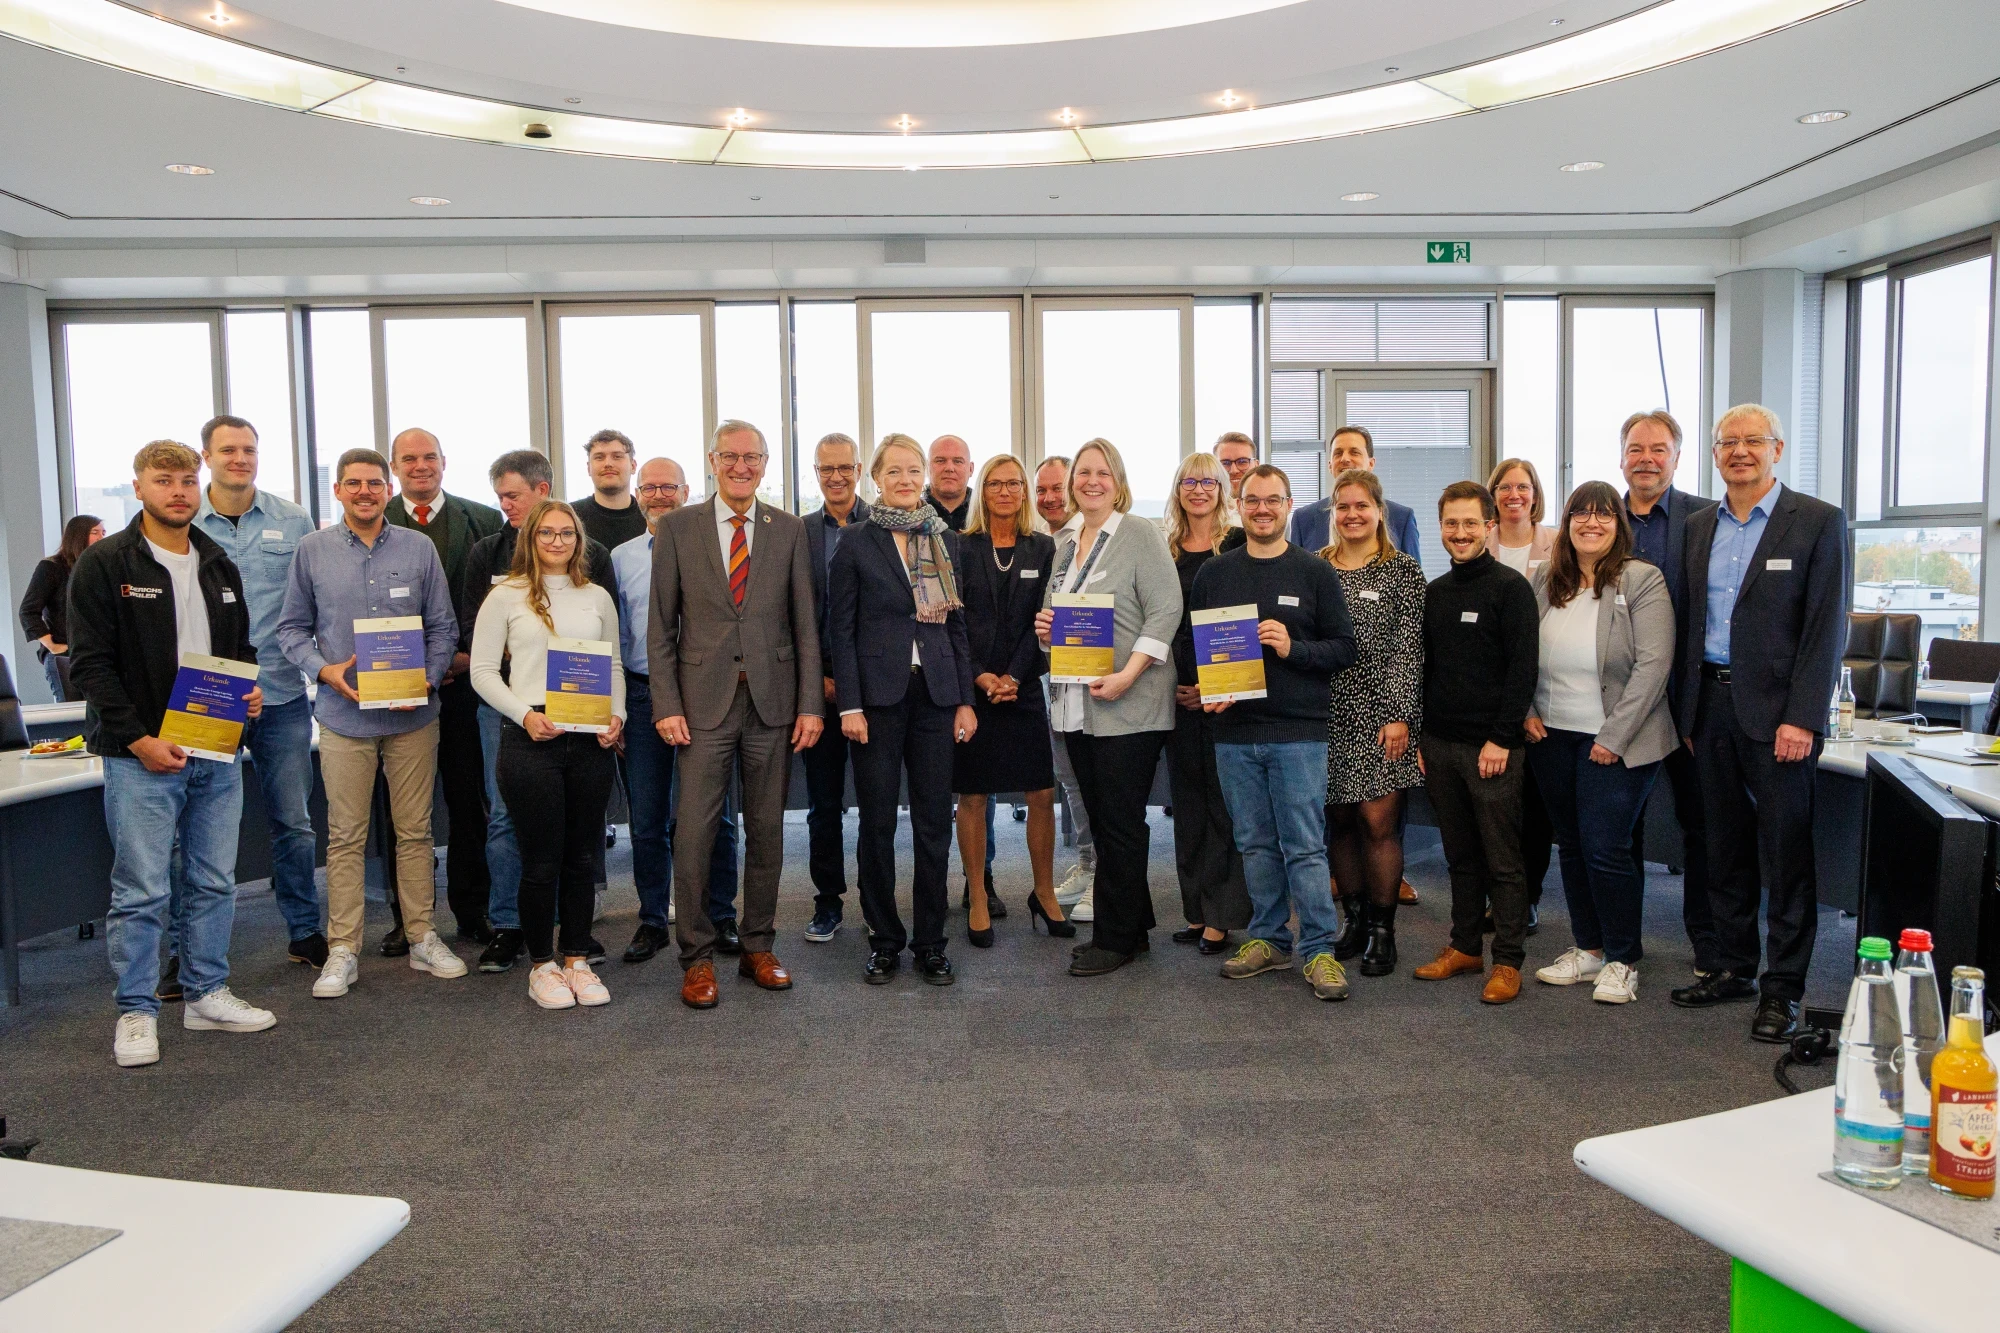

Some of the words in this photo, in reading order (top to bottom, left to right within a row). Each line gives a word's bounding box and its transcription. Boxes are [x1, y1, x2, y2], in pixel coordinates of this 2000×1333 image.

[568, 655, 591, 663] Urkunde
[203, 675, 230, 685] Urkunde
[1968, 1113, 1994, 1124] APFEL
